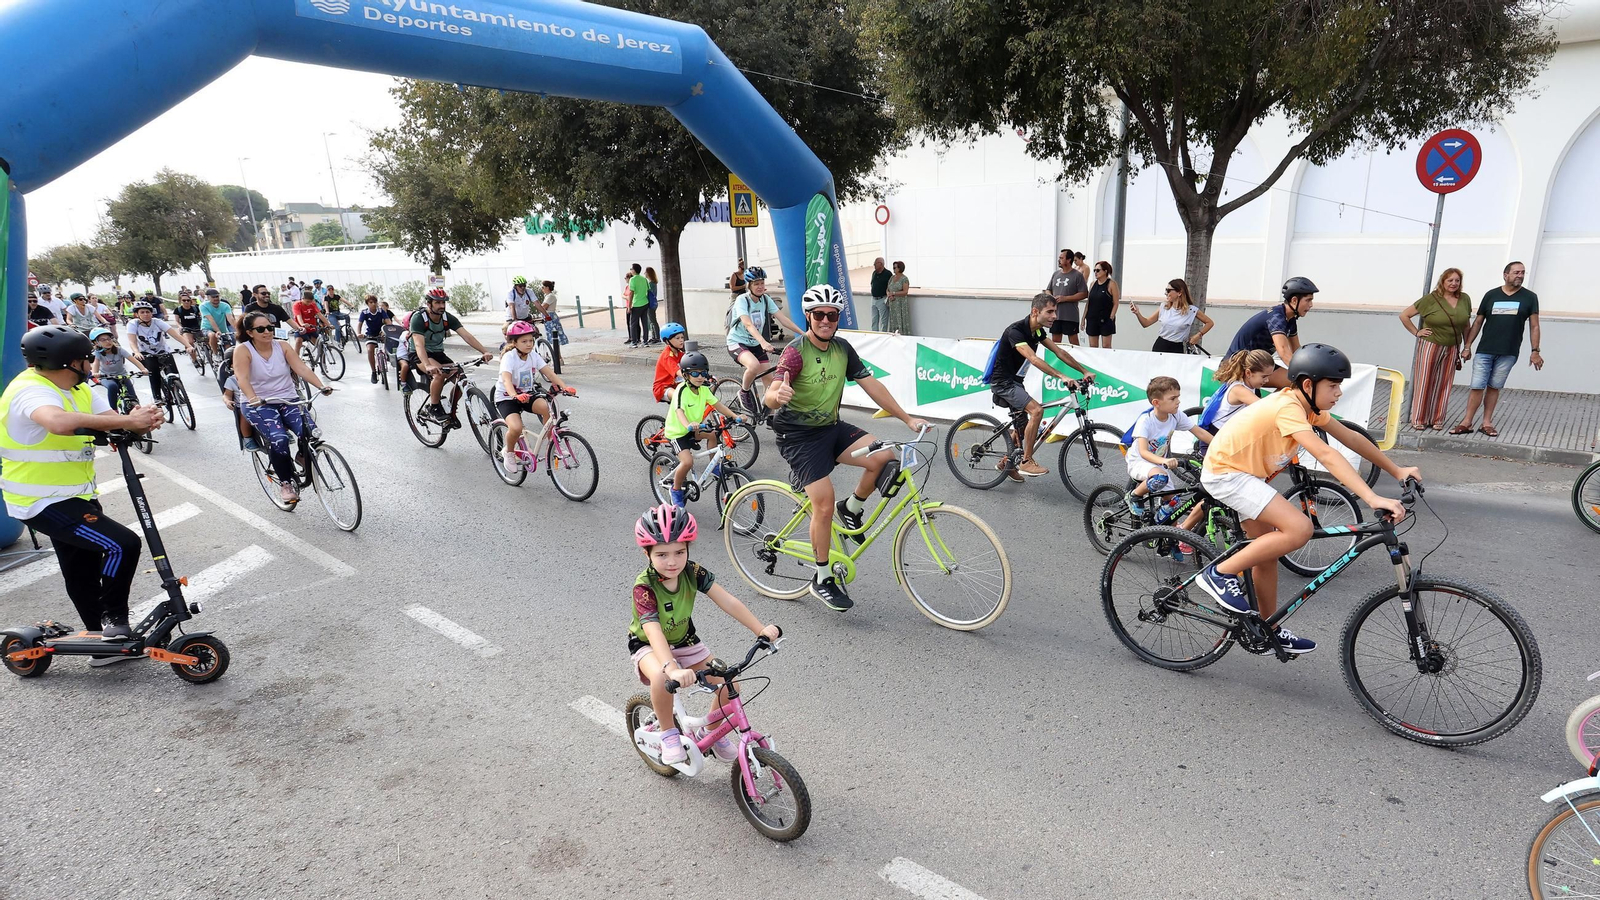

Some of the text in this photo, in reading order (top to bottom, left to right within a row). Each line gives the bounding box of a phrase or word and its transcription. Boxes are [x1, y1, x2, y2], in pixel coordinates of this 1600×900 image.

[363, 6, 473, 36] Deportes
[582, 29, 610, 44] de
[616, 33, 673, 54] Jerez
[917, 366, 928, 381] El
[927, 368, 951, 384] Corte
[1044, 374, 1057, 391] El
[1304, 546, 1360, 592] TREK
